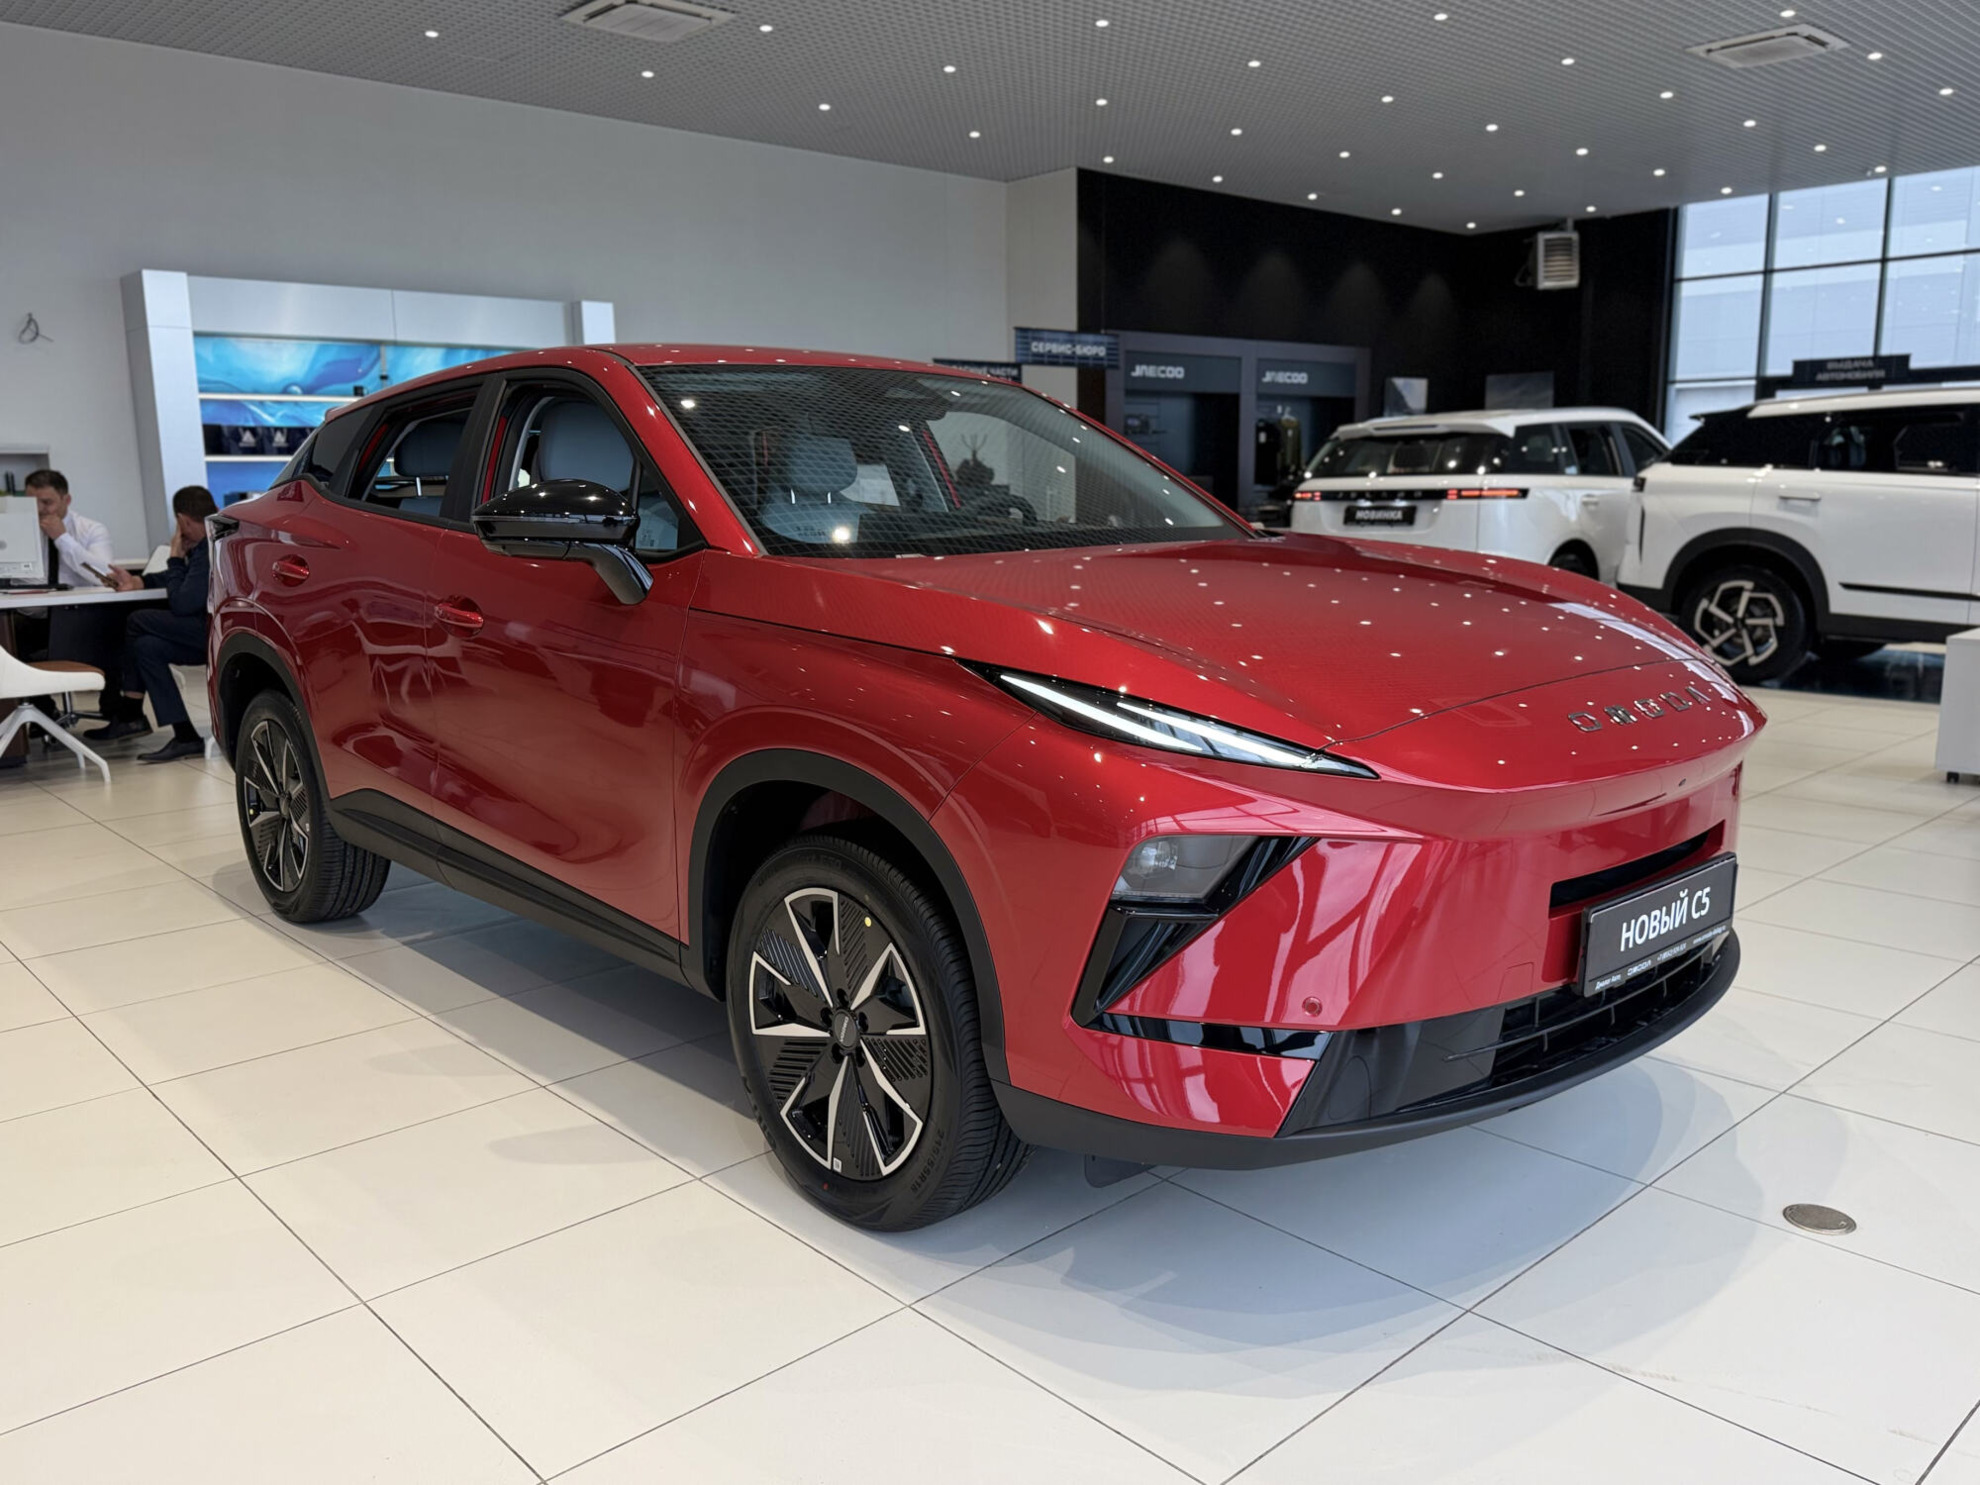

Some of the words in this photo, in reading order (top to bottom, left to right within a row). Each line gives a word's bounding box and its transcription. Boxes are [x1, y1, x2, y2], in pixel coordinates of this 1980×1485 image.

[1030, 340, 1107, 357] СЕРВИС-БЮРО
[1130, 364, 1185, 379] JAECOO
[1261, 370, 1308, 385] JAECOO
[1567, 686, 1712, 733] OMODA
[1620, 888, 1689, 952] НОВЫЙ
